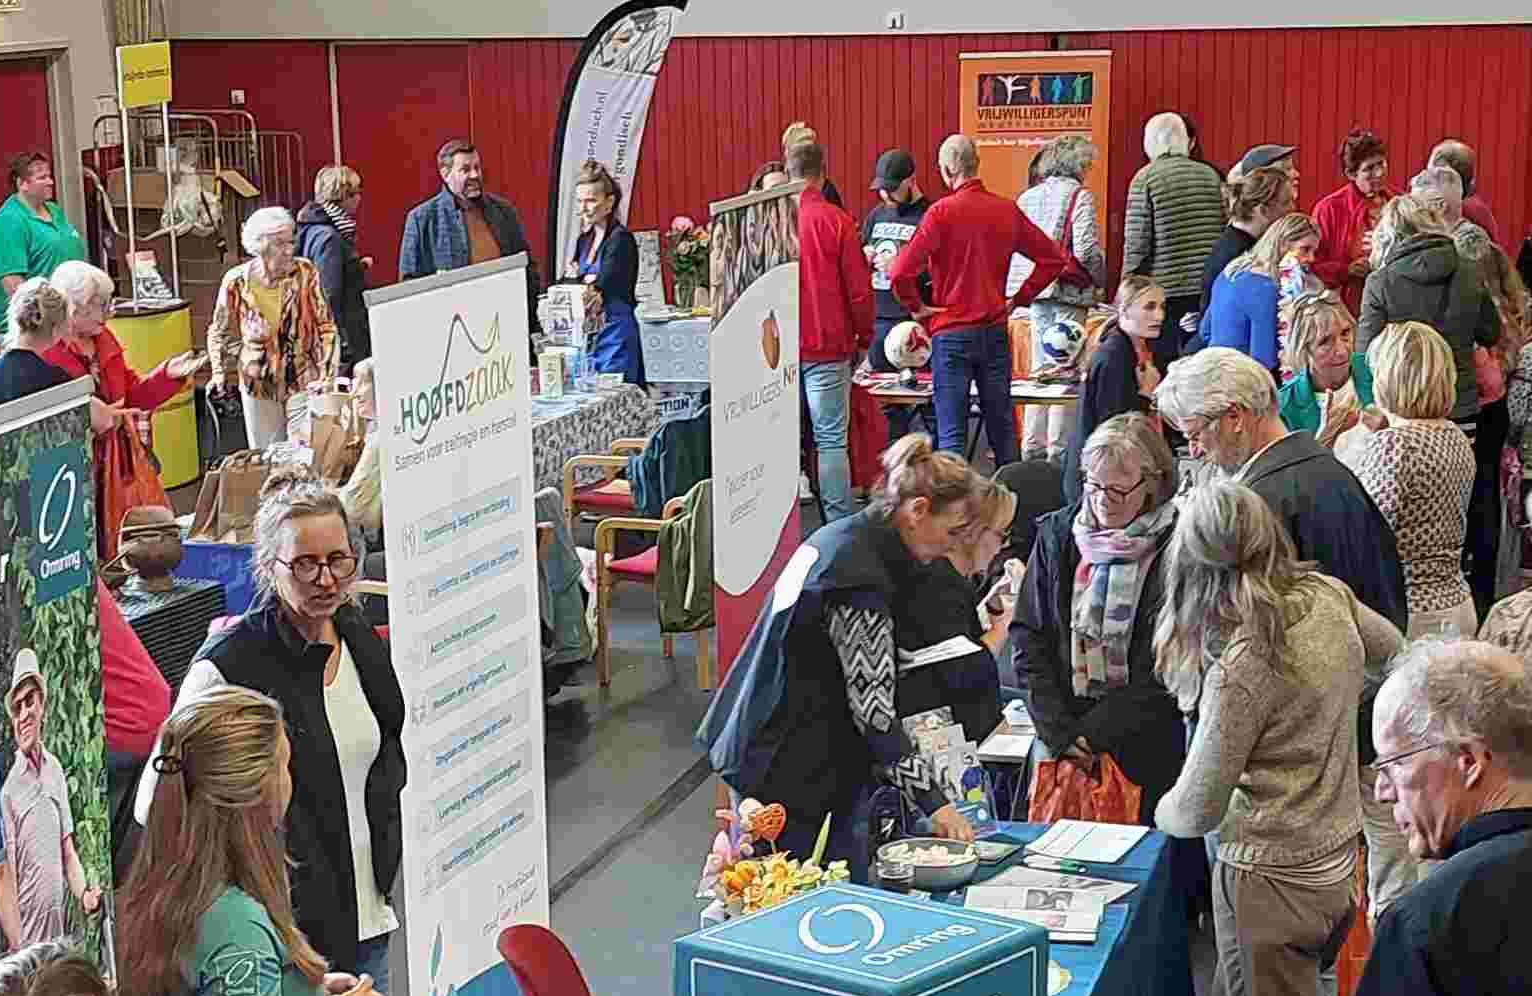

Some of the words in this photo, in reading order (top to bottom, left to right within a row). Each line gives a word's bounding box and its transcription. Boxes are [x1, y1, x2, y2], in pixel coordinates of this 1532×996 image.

[978, 106, 1093, 120] VRIJWILLIGERSPUNT
[40, 550, 81, 579] Omring
[861, 921, 978, 966] Omring
